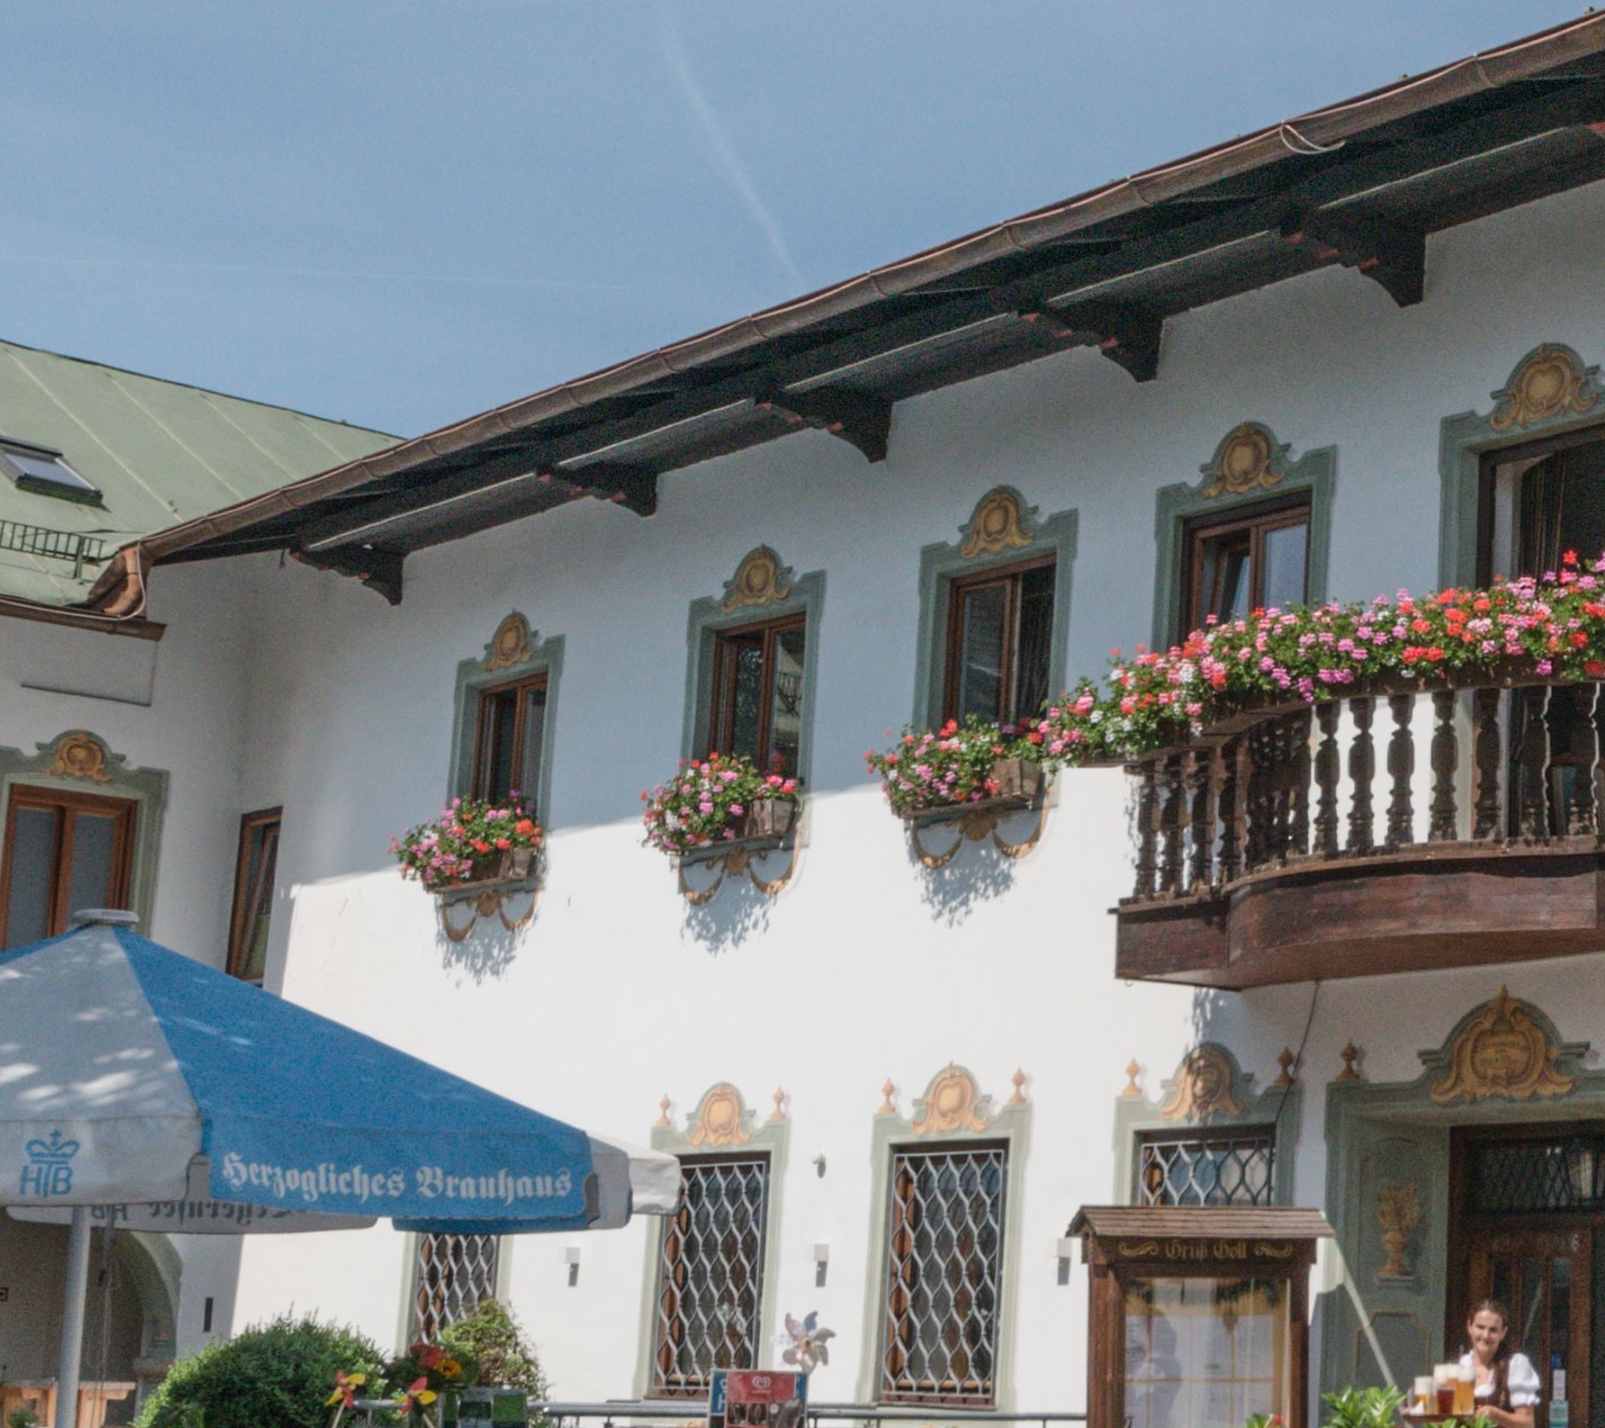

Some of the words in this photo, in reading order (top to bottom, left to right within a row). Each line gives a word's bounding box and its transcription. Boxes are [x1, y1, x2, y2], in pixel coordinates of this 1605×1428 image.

[18, 1161, 74, 1198] HTB
[222, 1150, 406, 1205] Herzogliches
[416, 1166, 574, 1206] Brauhaus
